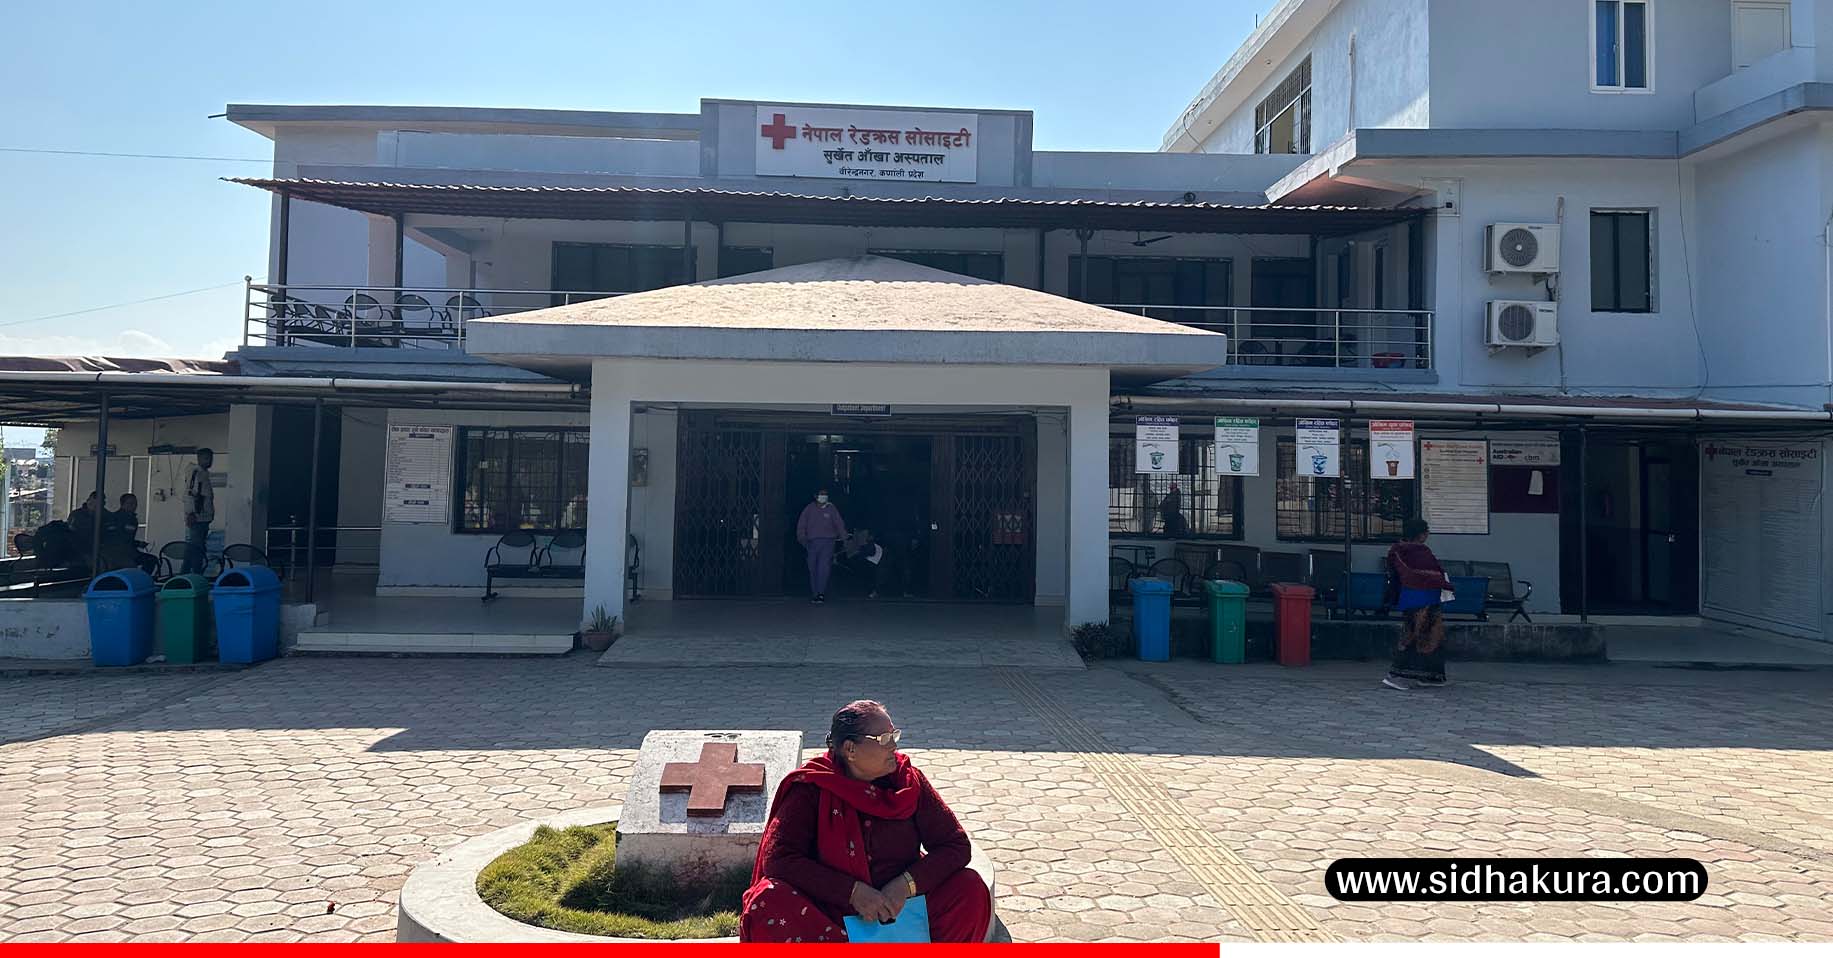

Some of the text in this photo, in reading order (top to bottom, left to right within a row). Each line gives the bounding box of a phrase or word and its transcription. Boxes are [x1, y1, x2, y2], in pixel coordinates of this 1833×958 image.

[802, 123, 972, 150] नेपाल रेडक्रस सोसाइटी
[823, 147, 945, 166] सुर्खेत आँखा अस्पताल
[908, 169, 925, 179] प्रदेश
